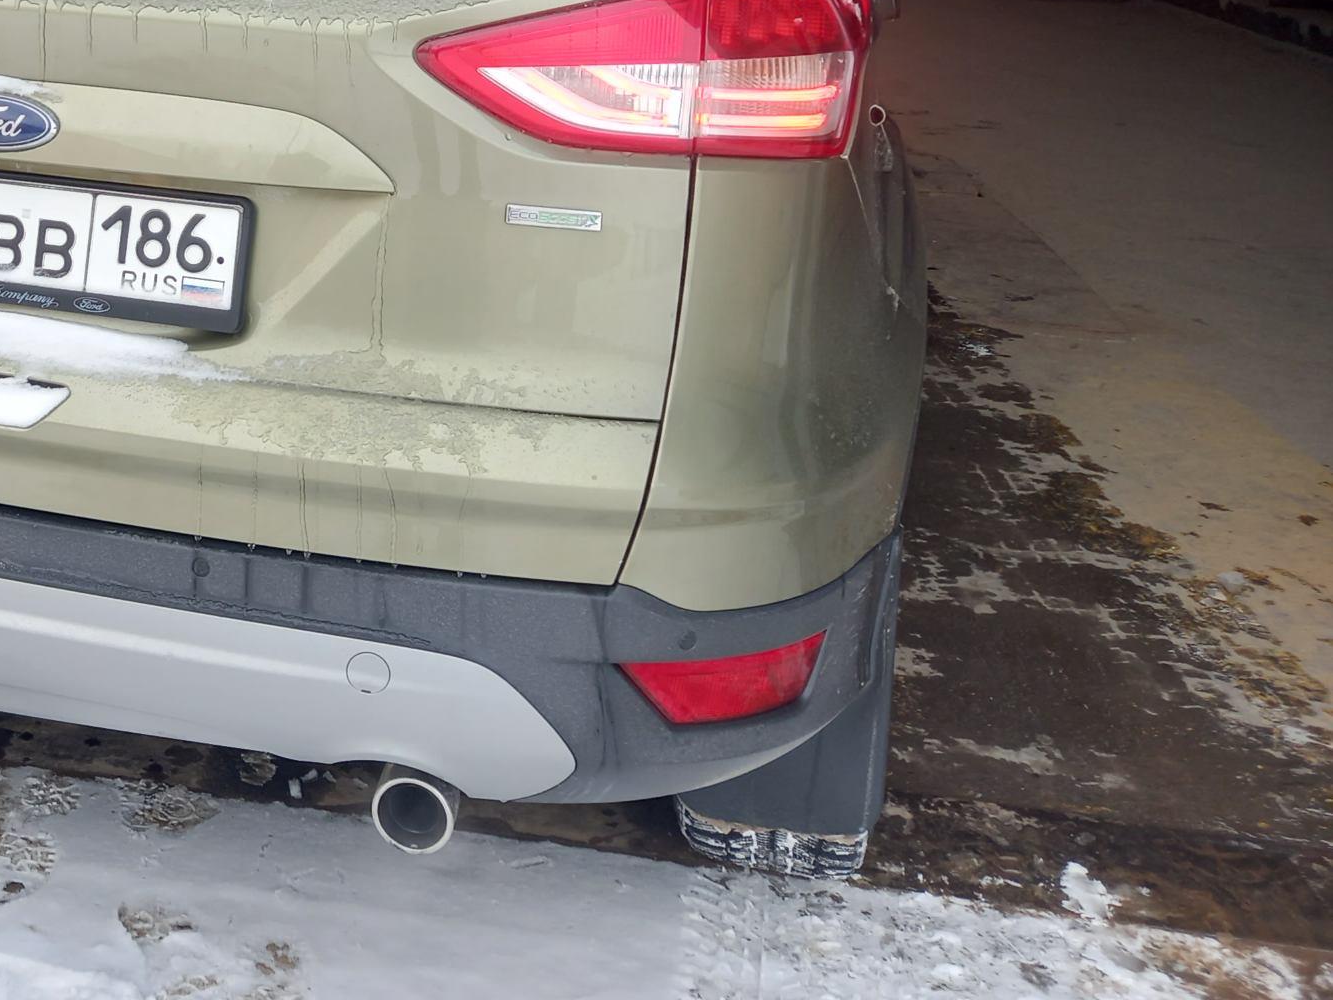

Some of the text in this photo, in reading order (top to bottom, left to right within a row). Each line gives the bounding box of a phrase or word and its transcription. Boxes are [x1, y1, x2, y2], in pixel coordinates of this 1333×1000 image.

[102, 204, 213, 273] 186
[120, 269, 178, 296] RUS
[80, 298, 105, 311] Ford
